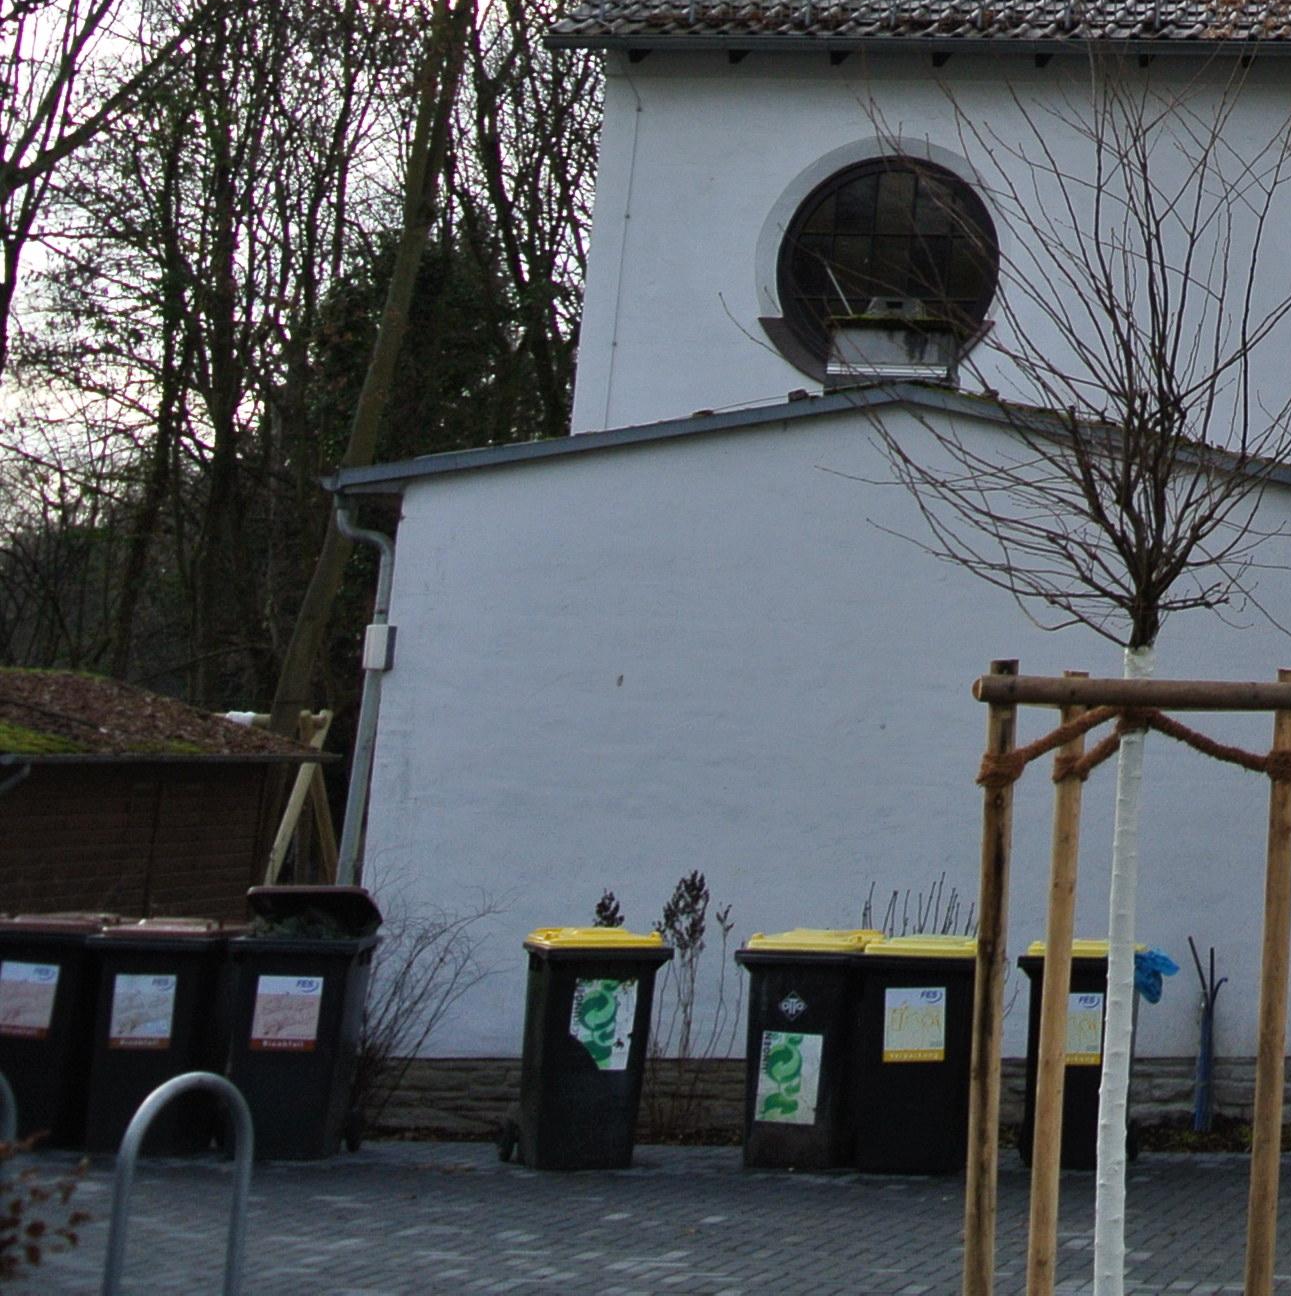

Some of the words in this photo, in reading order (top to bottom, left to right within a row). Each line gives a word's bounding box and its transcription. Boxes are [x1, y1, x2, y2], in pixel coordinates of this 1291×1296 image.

[296, 979, 315, 989] FES
[920, 990, 939, 999] FES
[1079, 995, 1098, 1004] FES
